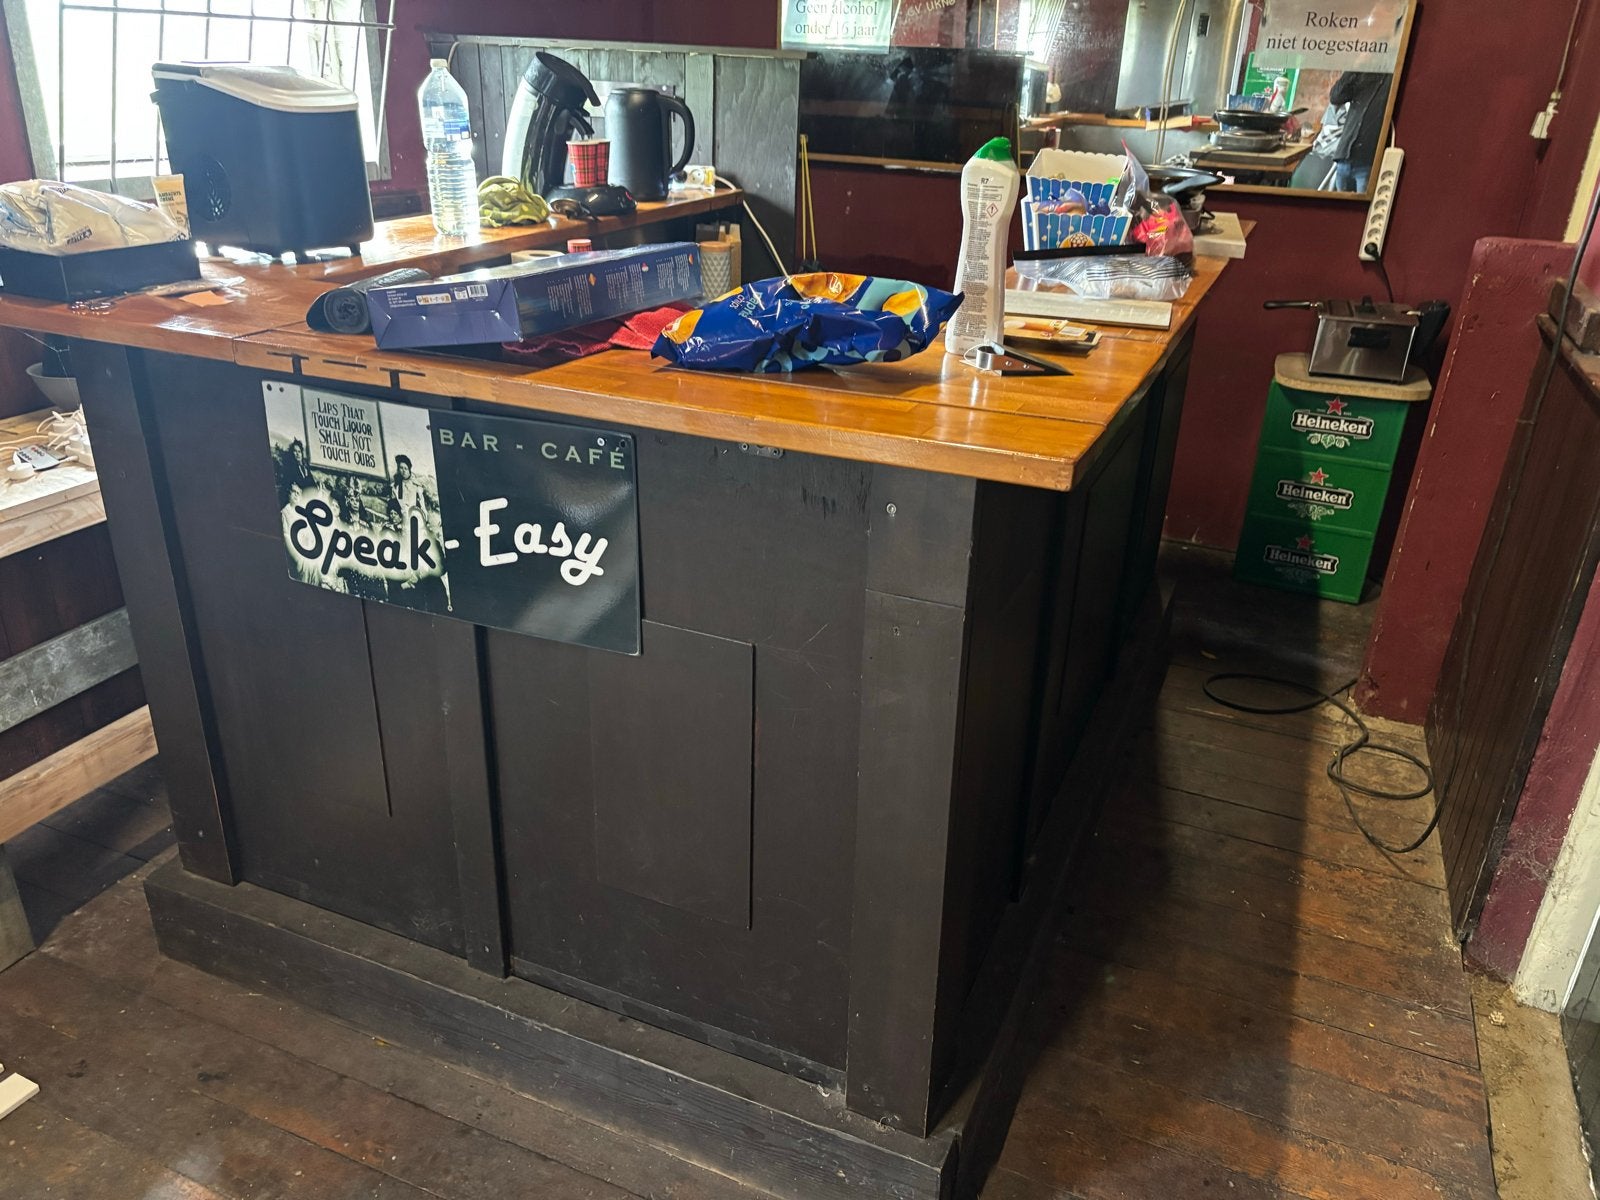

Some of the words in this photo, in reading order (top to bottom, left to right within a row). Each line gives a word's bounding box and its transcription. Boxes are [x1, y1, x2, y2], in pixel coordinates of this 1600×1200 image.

[795, 0, 827, 14] Geen
[832, 0, 878, 15] alcohol
[795, 21, 830, 35] onder
[837, 21, 849, 35] 16
[852, 21, 878, 39] jaar
[1305, 11, 1358, 28] Roken
[1266, 34, 1297, 50] niet
[1302, 37, 1388, 56] toegestaan
[317, 397, 339, 416] LIPS
[341, 403, 365, 420] THAT
[312, 411, 341, 430] TOUCH
[342, 416, 373, 436] LIQUOR
[1295, 413, 1368, 435] Heineken
[319, 429, 350, 448] SHALL
[352, 433, 371, 452] NOT
[439, 428, 499, 452] BAR
[541, 442, 625, 470] CAFÉ
[320, 445, 350, 463] TOUCH
[353, 452, 376, 468] OURS
[1282, 484, 1348, 505] Heineken
[474, 497, 608, 586] Easy
[1269, 548, 1332, 570] Heineken
